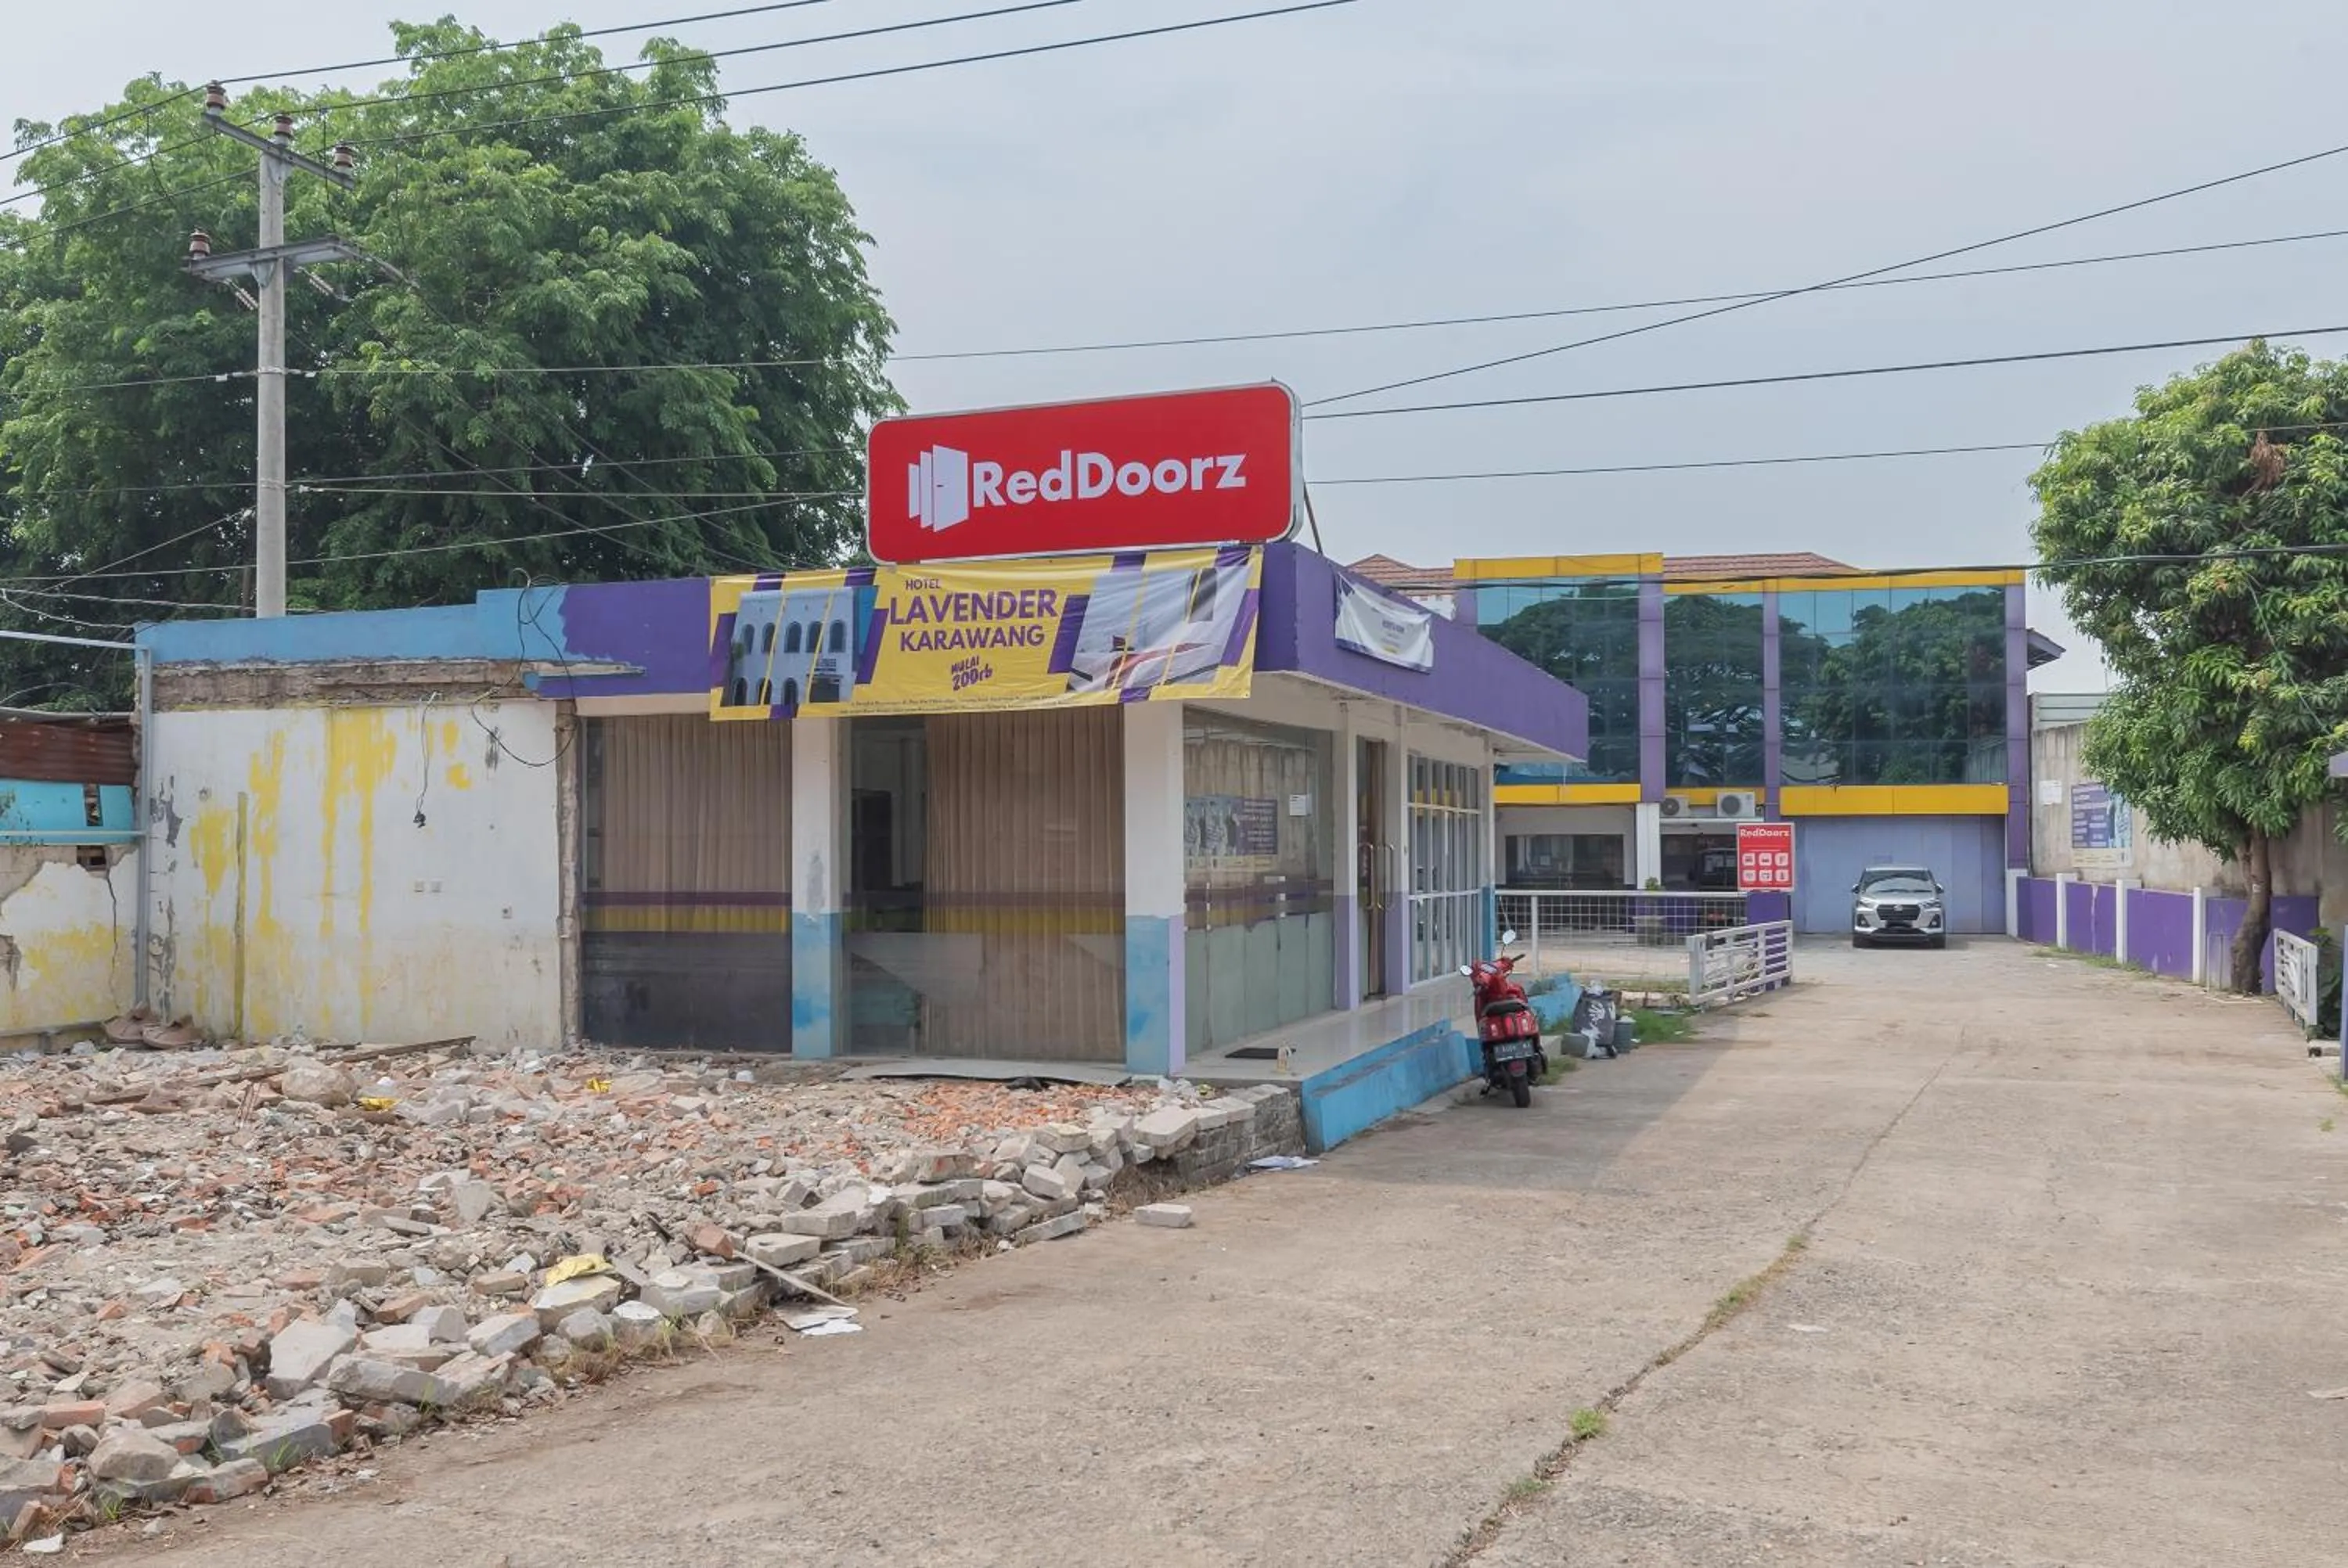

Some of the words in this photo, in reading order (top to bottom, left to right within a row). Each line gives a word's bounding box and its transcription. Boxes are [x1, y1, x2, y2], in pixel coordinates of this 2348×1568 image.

[973, 450, 1247, 508] RedDoorz
[905, 579, 941, 590] HOTEL
[890, 589, 1058, 624] LAVENDER
[900, 624, 1045, 651] KARAWANG
[951, 655, 979, 674] MULAI
[953, 664, 993, 691] 200rb
[1740, 829, 1790, 837] RedDoorz
